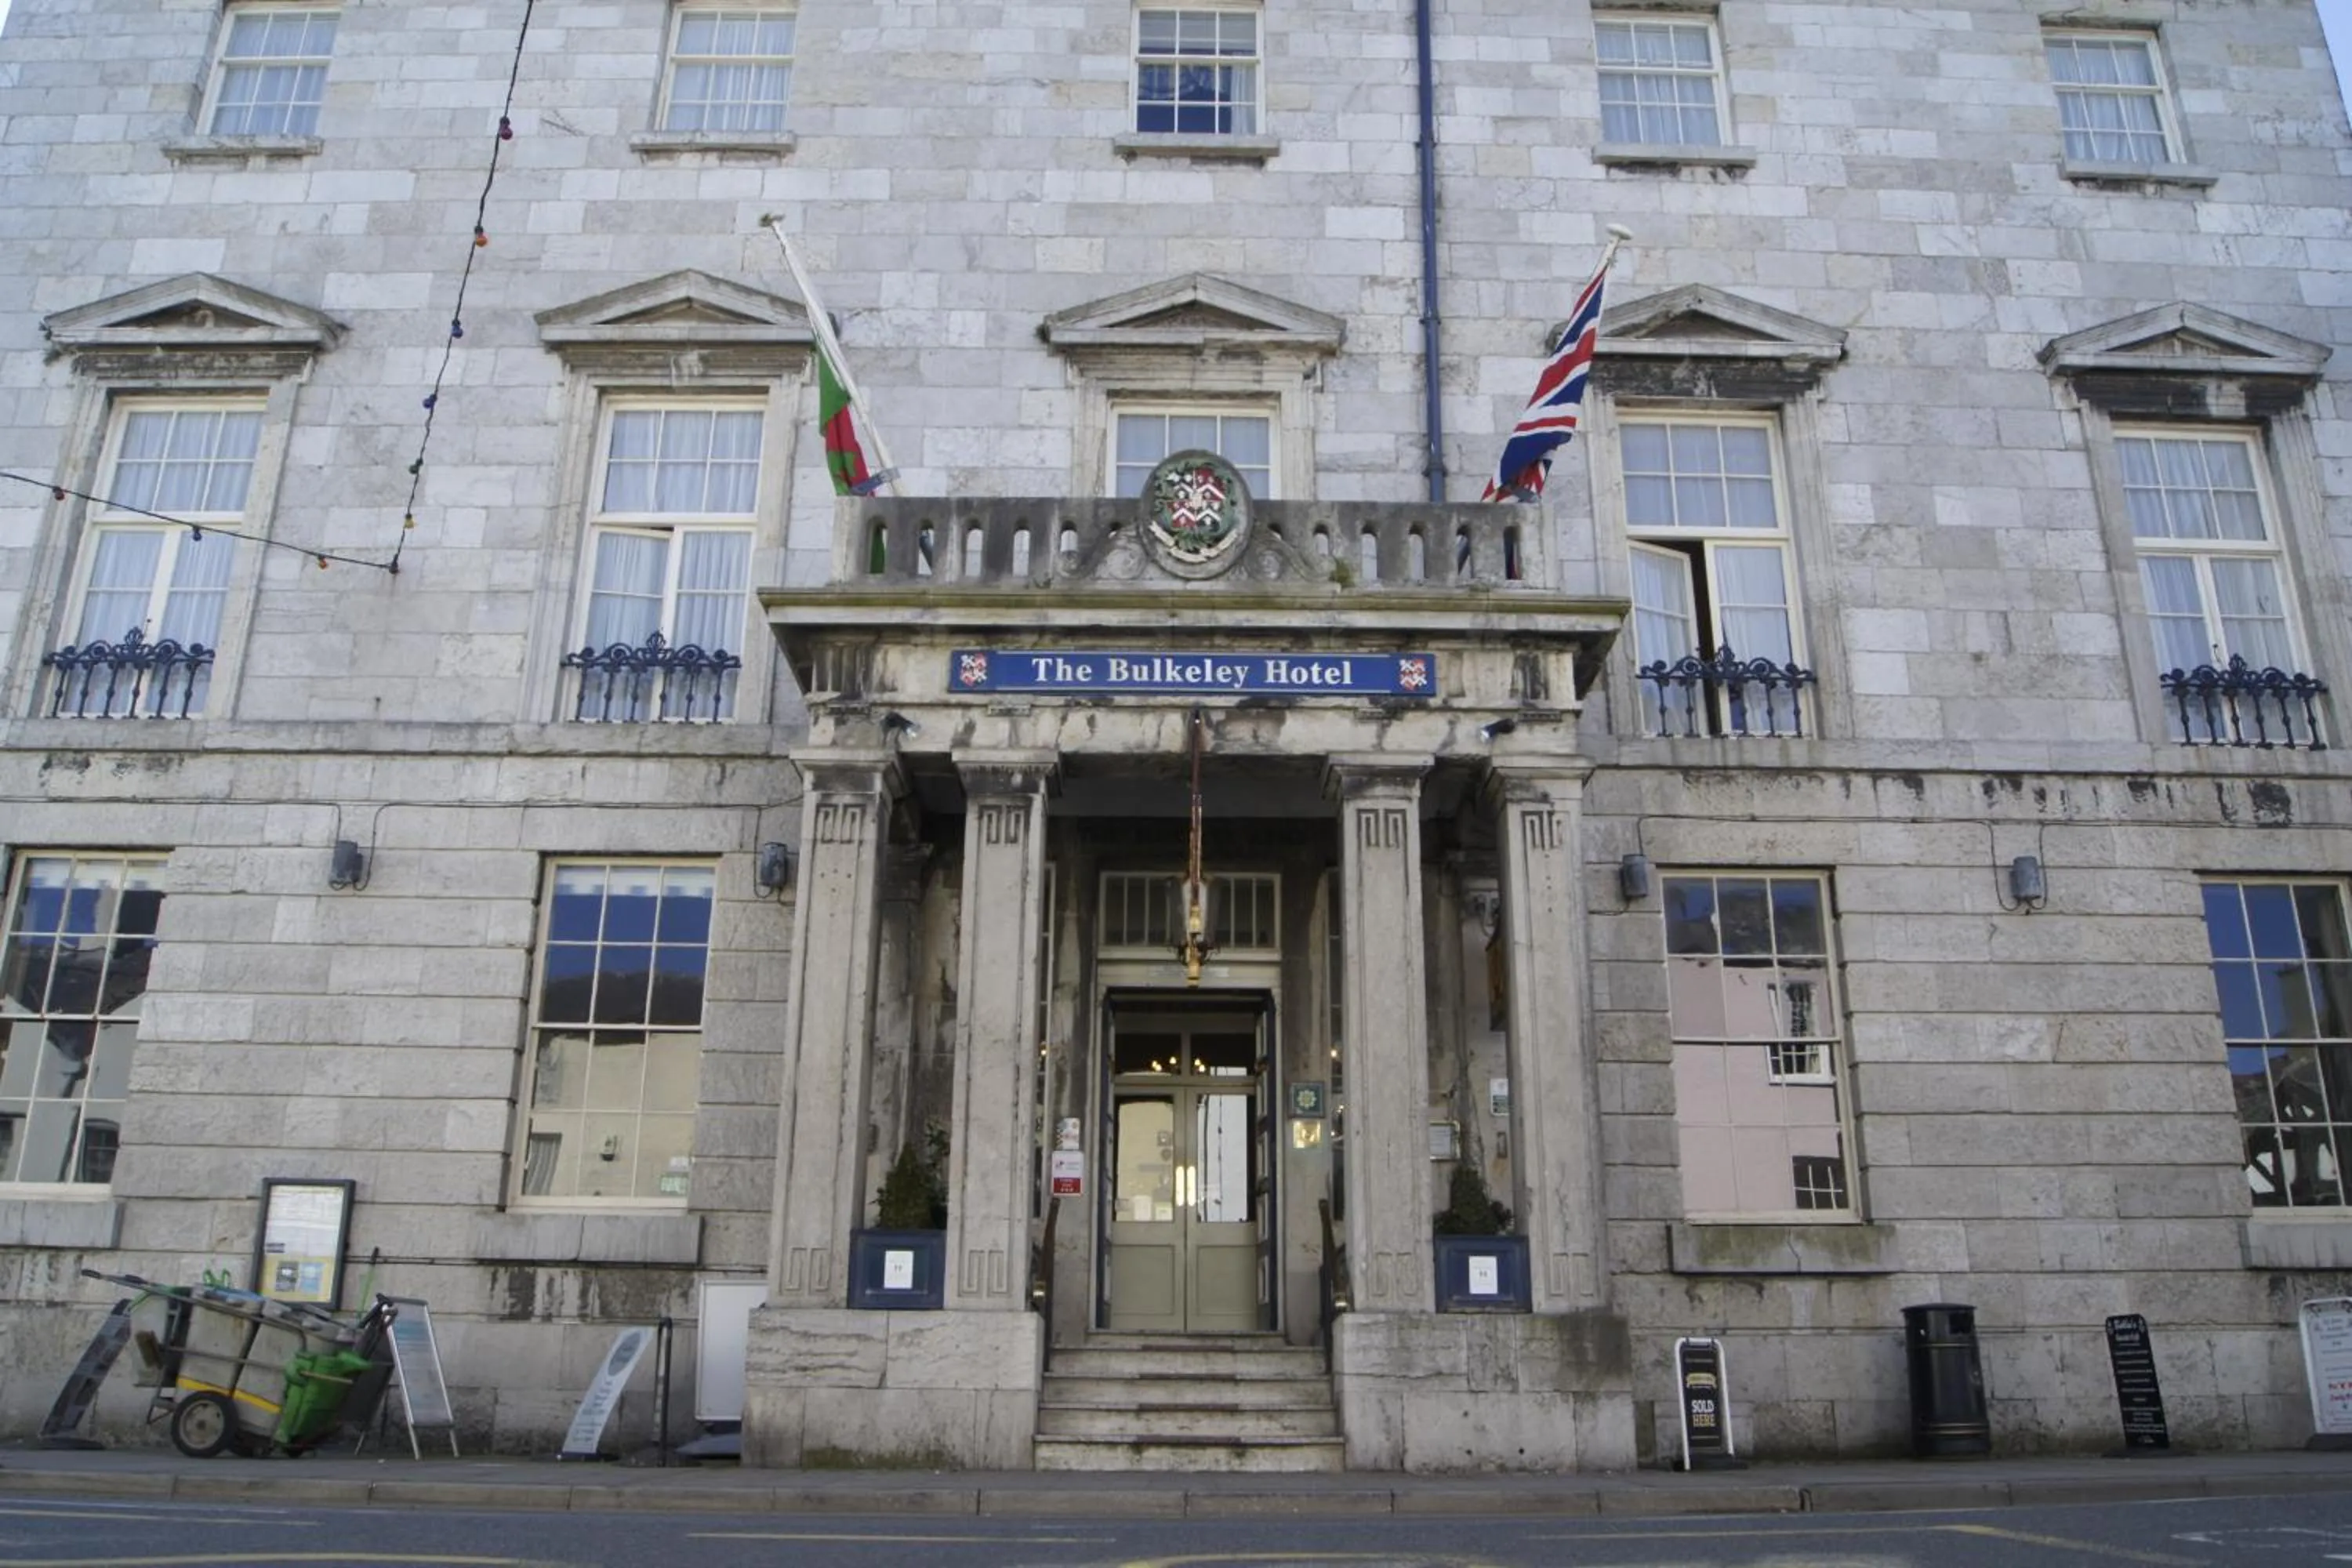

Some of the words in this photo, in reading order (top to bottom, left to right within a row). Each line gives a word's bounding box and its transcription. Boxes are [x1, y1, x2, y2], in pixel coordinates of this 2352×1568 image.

[1032, 658, 1092, 681] The
[1107, 658, 1249, 688] Bulkeley
[1264, 659, 1353, 684] Hotel
[1691, 1399, 1715, 1412] SOLD
[1692, 1414, 1716, 1427] HERE
